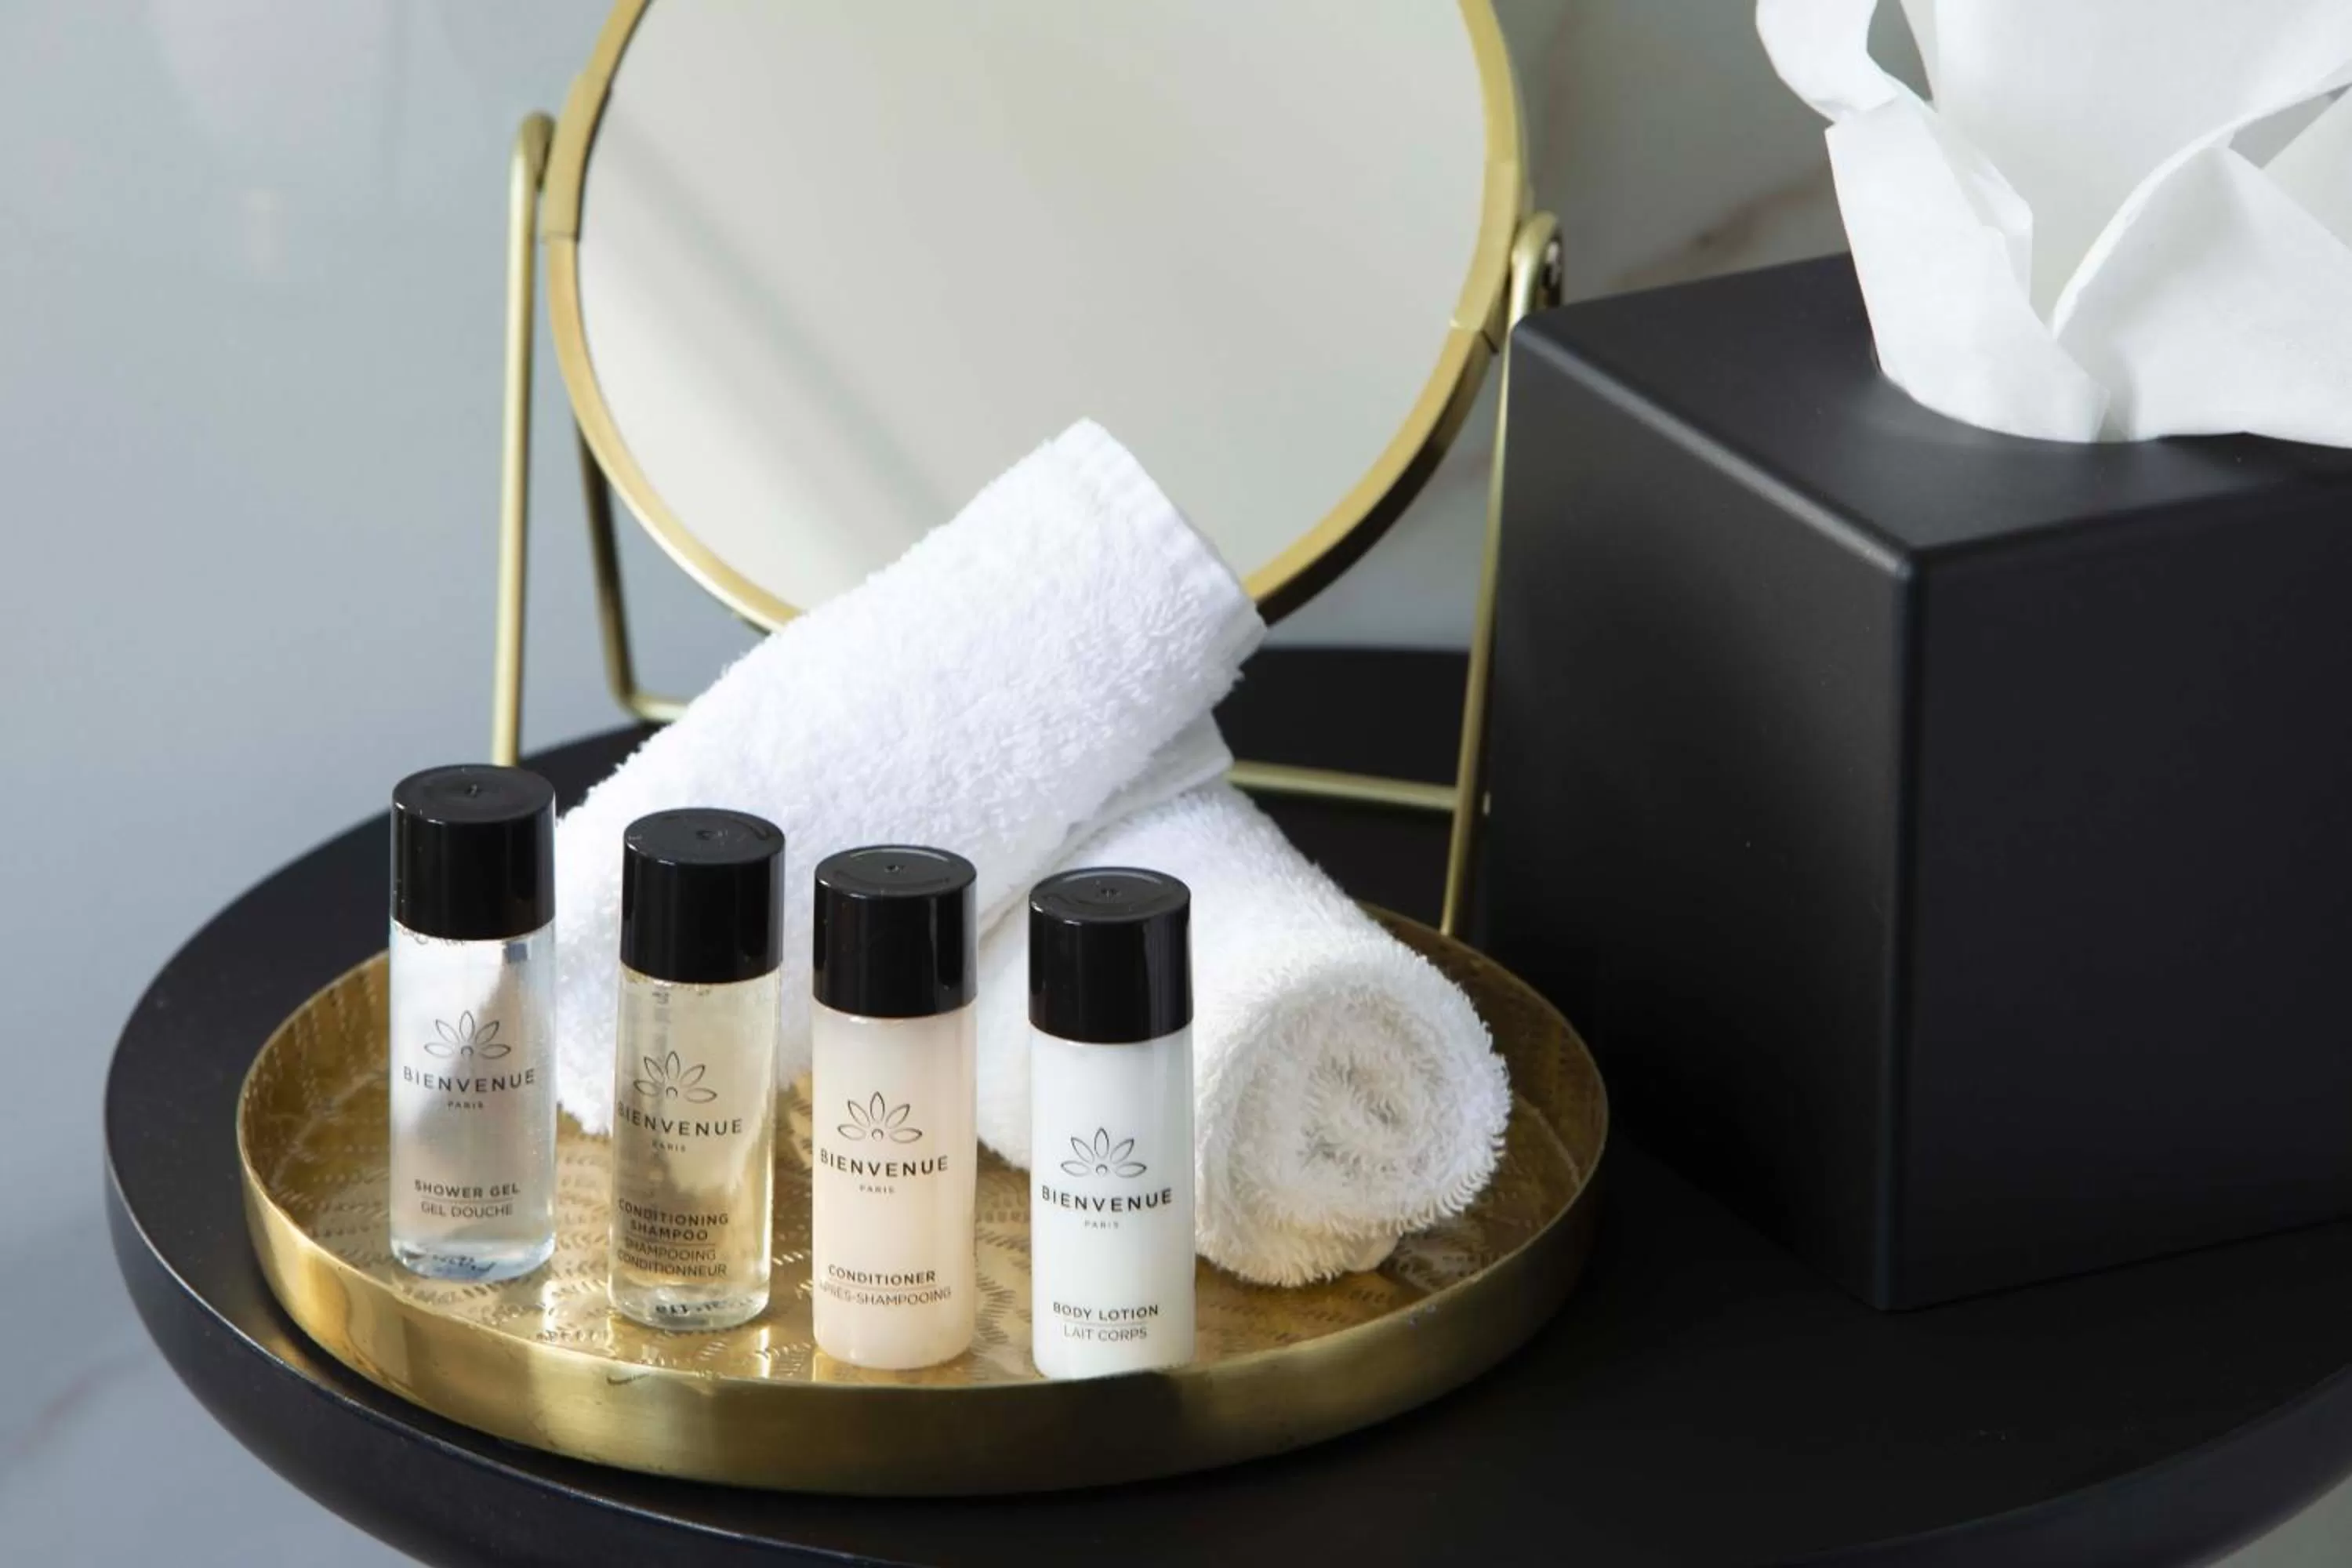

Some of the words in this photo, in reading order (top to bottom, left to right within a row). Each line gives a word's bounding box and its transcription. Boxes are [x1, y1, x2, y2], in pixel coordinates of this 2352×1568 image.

[404, 1065, 535, 1092] BIENVENUE
[448, 1101, 484, 1110] PARIS
[618, 1100, 742, 1136] BIENVENUE
[821, 1148, 948, 1178] BIENVENUE
[415, 1179, 483, 1198] SHOWER
[489, 1182, 521, 1197] GEL
[859, 1185, 895, 1194] PARIS
[1042, 1185, 1173, 1212] BIENVENUE
[420, 1201, 446, 1217] GEL
[451, 1203, 514, 1218] DOUCHE
[619, 1198, 729, 1226] CONDITIONING
[630, 1219, 708, 1241] SHAMPOO
[1084, 1220, 1120, 1229] PARIS
[626, 1236, 716, 1263] SHAMPOOING
[828, 1264, 935, 1286] CONDITIONER
[1053, 1301, 1092, 1321] BODY
[1099, 1305, 1158, 1322] LOTION
[1064, 1324, 1094, 1340] LAIT
[1098, 1327, 1148, 1342] CORPS
